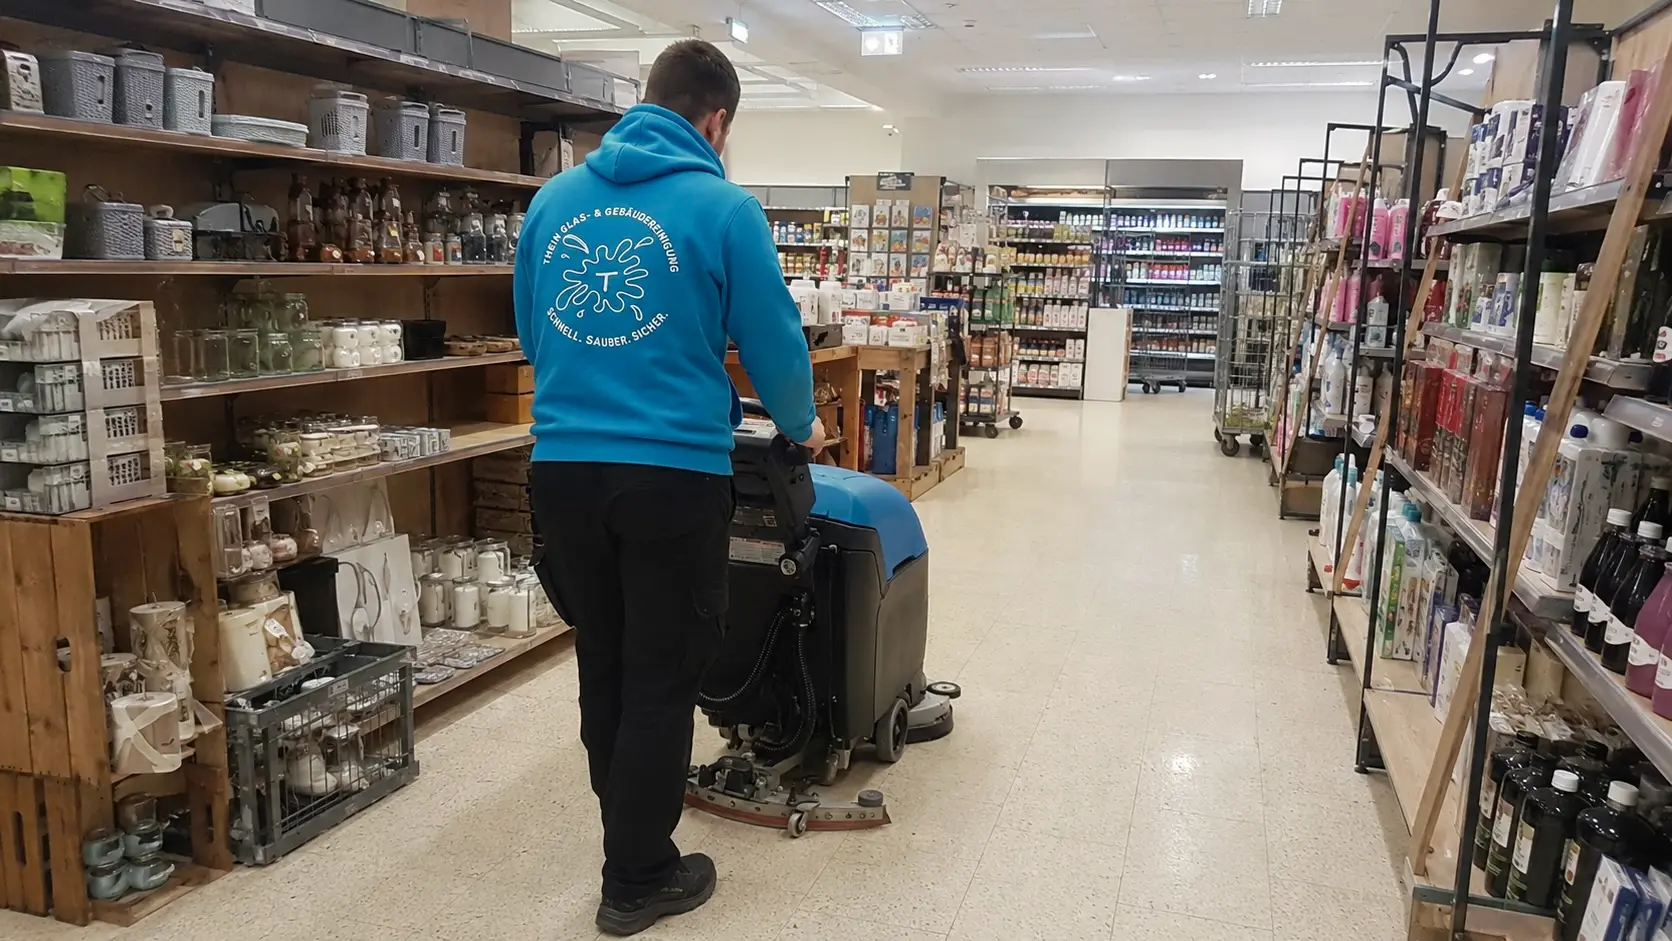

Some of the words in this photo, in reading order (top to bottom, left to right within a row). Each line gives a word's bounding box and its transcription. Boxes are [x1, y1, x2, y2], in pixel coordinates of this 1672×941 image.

[543, 233, 561, 265] THEIN
[560, 213, 591, 233] GLAS-
[594, 209, 602, 217] &
[605, 207, 679, 273] GEBÄUDEREINIGUNG
[595, 271, 618, 292] T
[546, 307, 582, 343] SCHNELL.
[585, 335, 631, 347] SAUBER.
[631, 312, 669, 341] SICHER.
